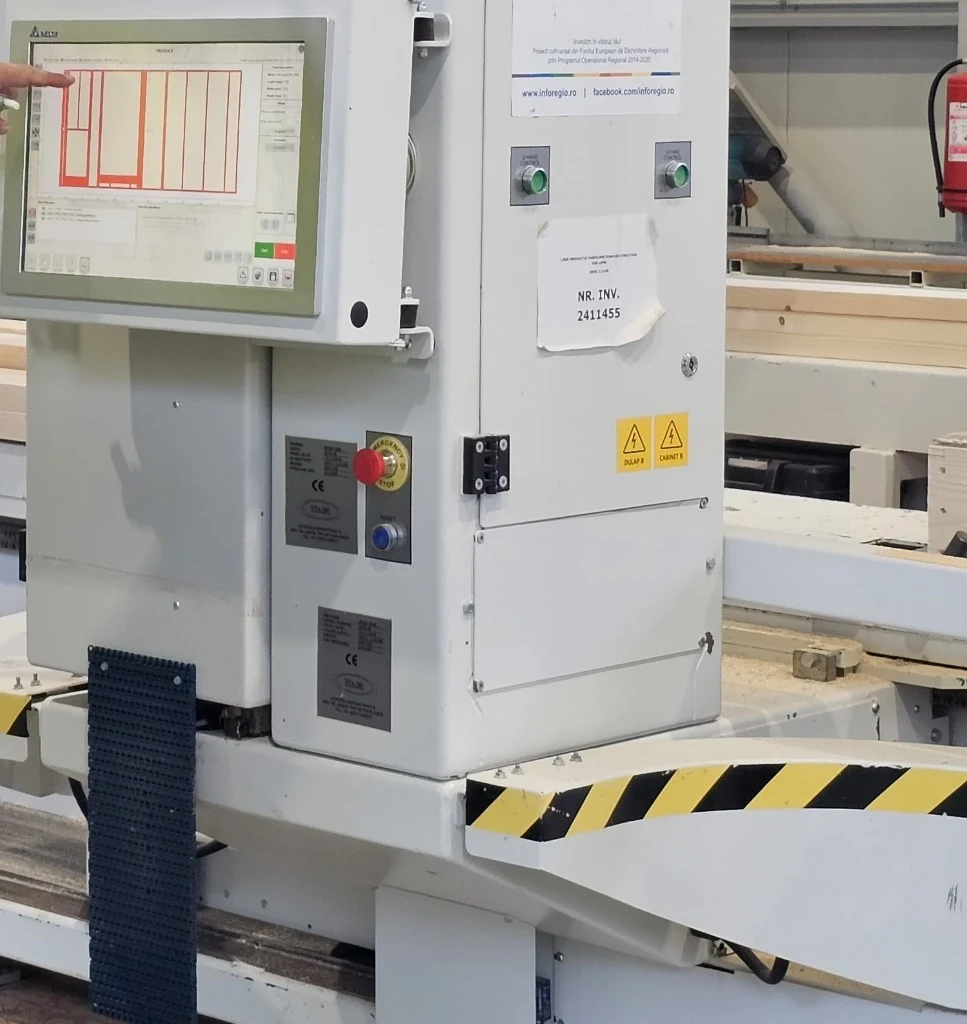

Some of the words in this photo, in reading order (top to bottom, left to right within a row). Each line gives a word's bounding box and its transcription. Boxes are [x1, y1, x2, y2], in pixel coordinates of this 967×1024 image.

[522, 87, 577, 99] www.inforegio.ro
[593, 85, 675, 97] facebook.com/inforegio.ro
[577, 290, 595, 302] NR.
[598, 288, 620, 301] INV.
[577, 307, 621, 322] 2411455
